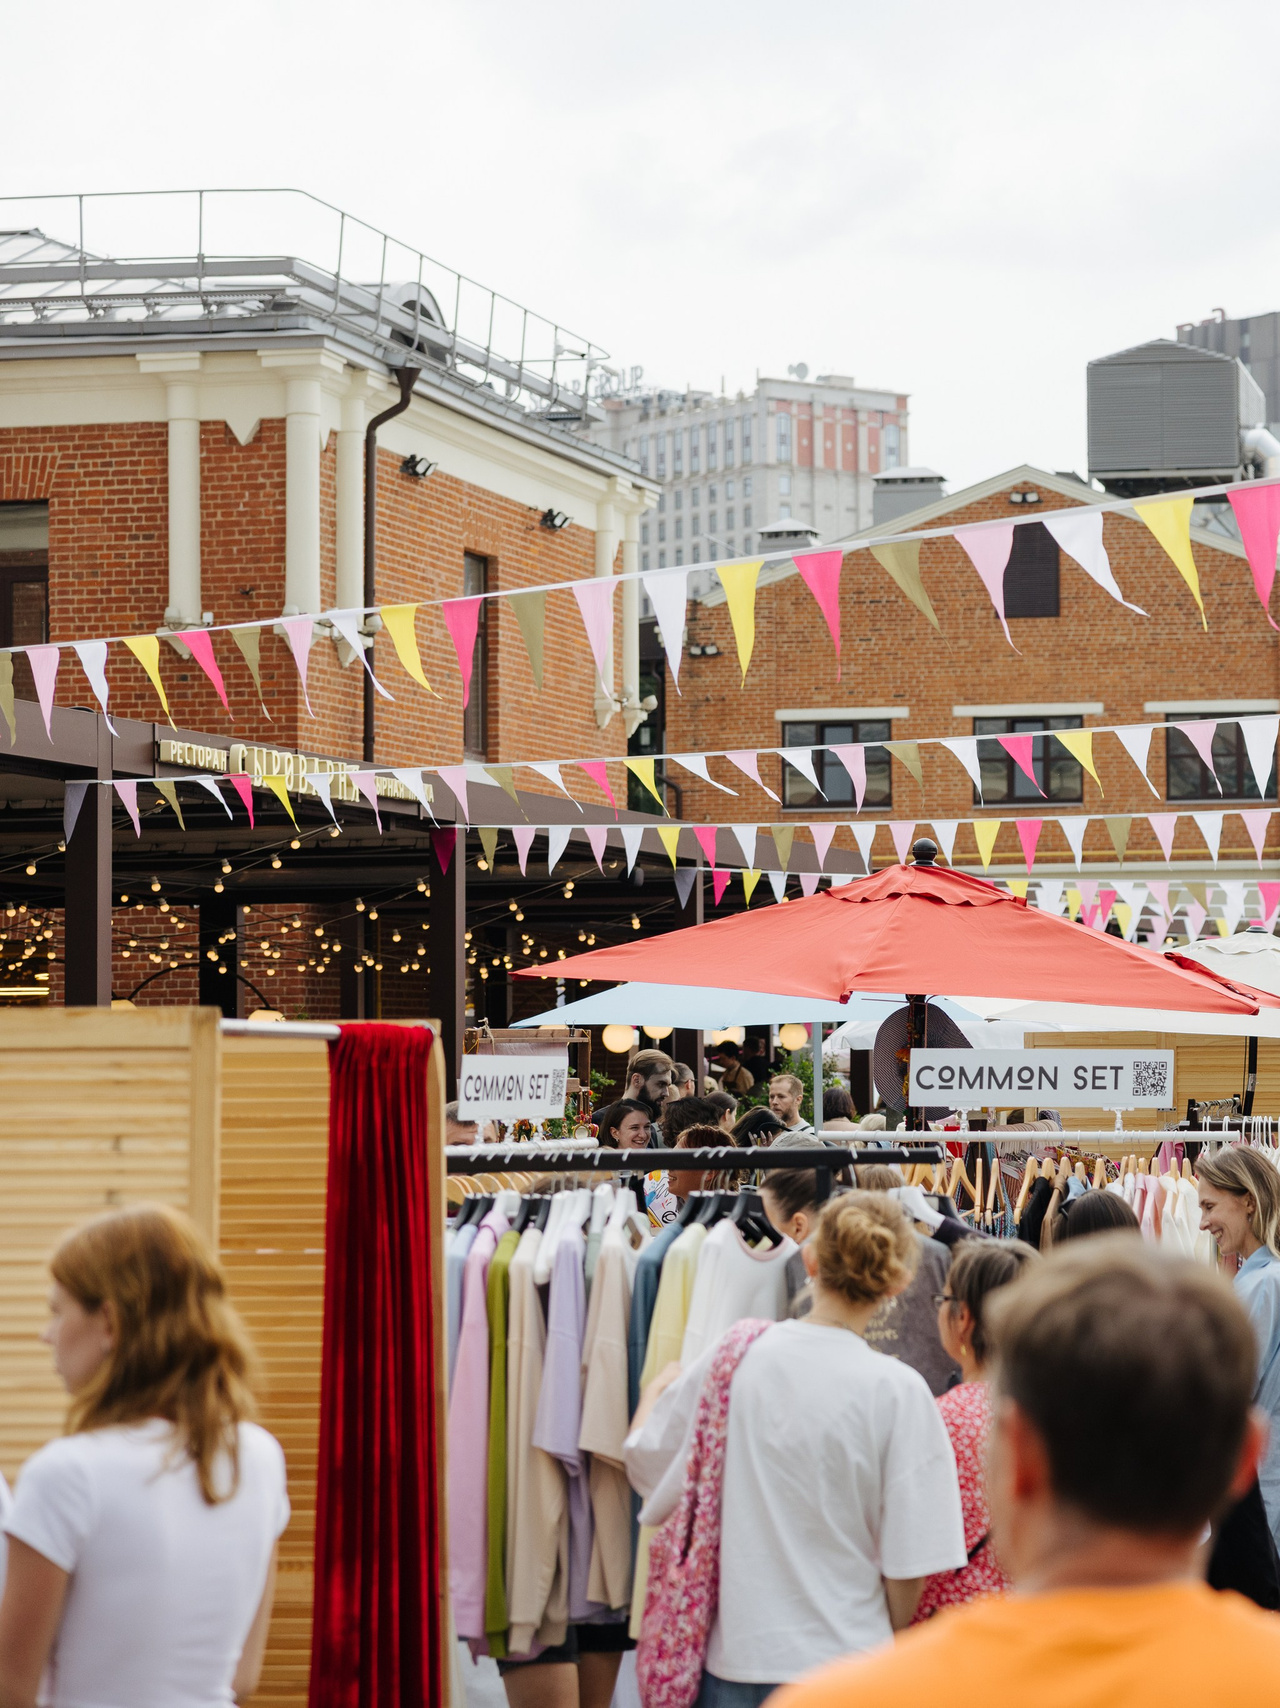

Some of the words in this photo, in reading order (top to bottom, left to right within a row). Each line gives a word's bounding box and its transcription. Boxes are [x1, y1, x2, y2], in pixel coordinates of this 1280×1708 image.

[170, 742, 227, 772] РЕСТОРАН
[373, 776, 405, 799] ЫРНАЯ
[464, 1075, 525, 1101] COMMON
[528, 1074, 550, 1100] SET
[915, 1065, 1059, 1090] COMMON
[1073, 1065, 1124, 1090] SET
